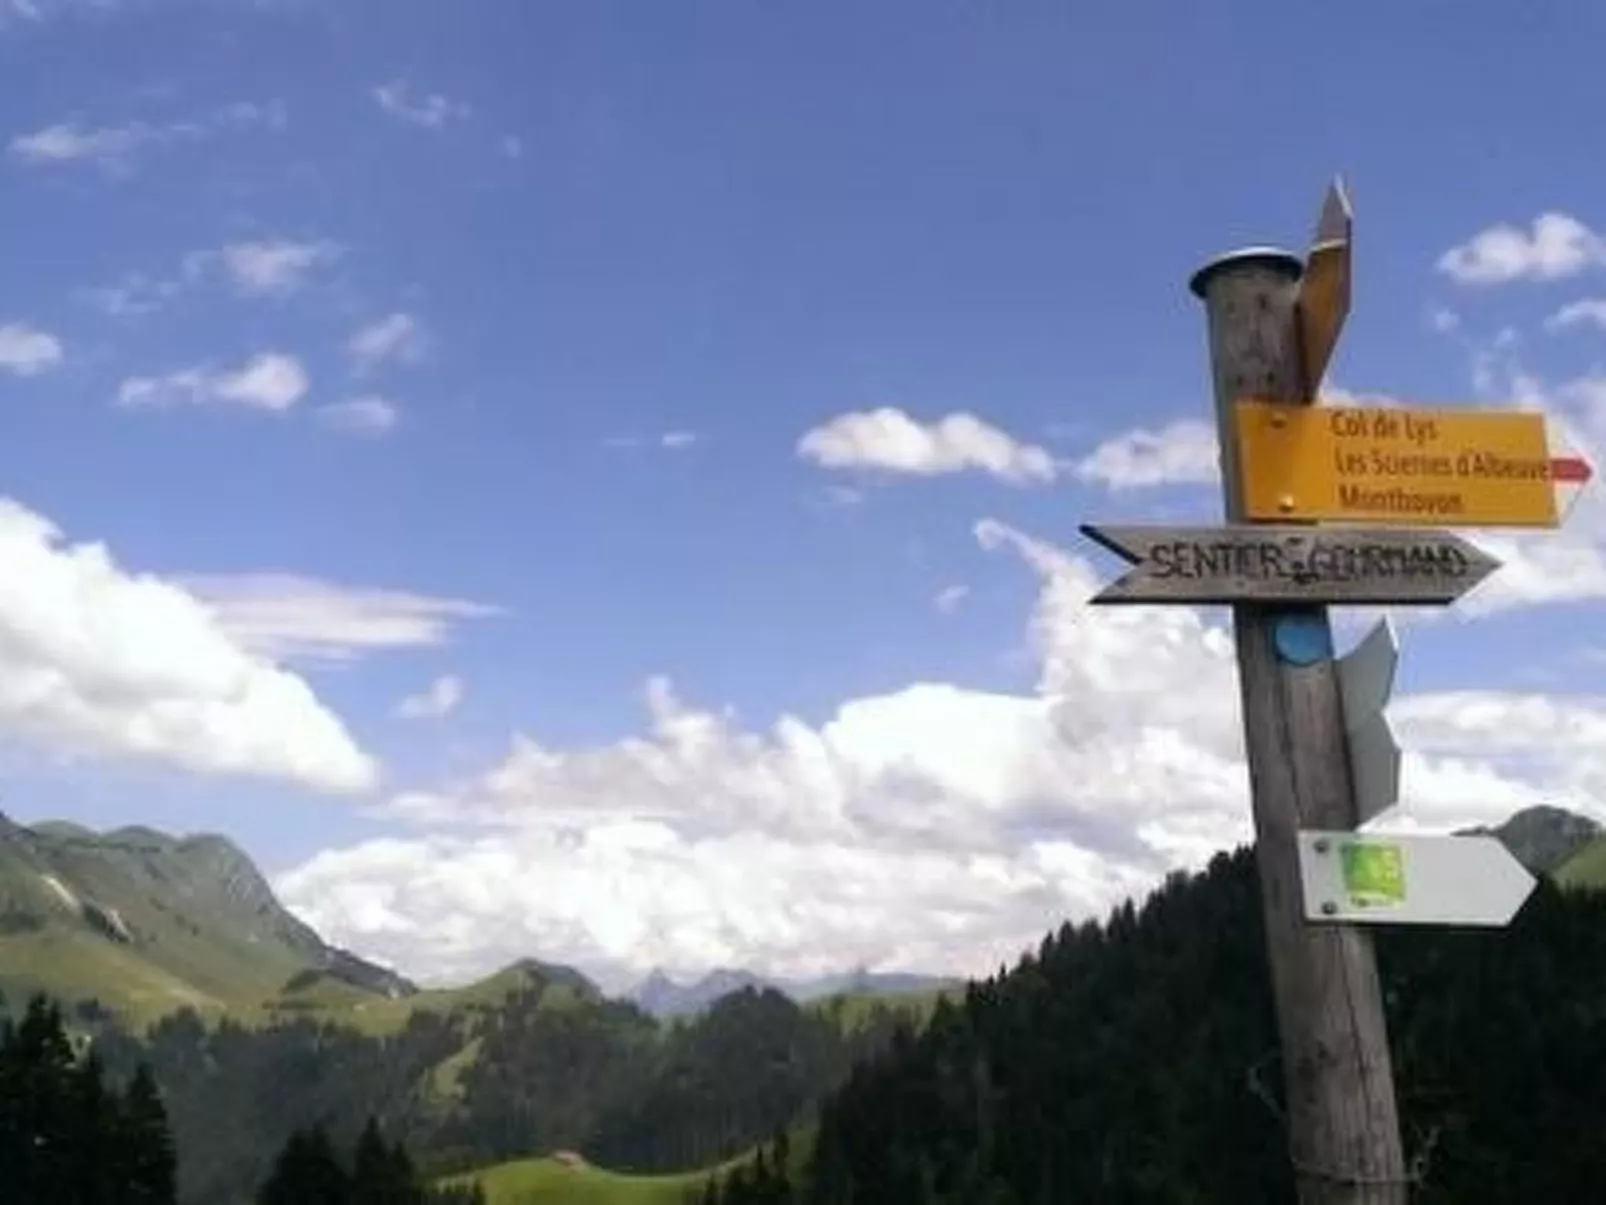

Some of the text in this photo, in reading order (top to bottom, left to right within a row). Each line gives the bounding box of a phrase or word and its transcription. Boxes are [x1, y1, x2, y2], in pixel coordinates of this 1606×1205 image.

[1330, 409, 1439, 446] Col de Lys
[1334, 447, 1368, 476] Les
[1150, 541, 1470, 582] SENTIER GOURMAND
